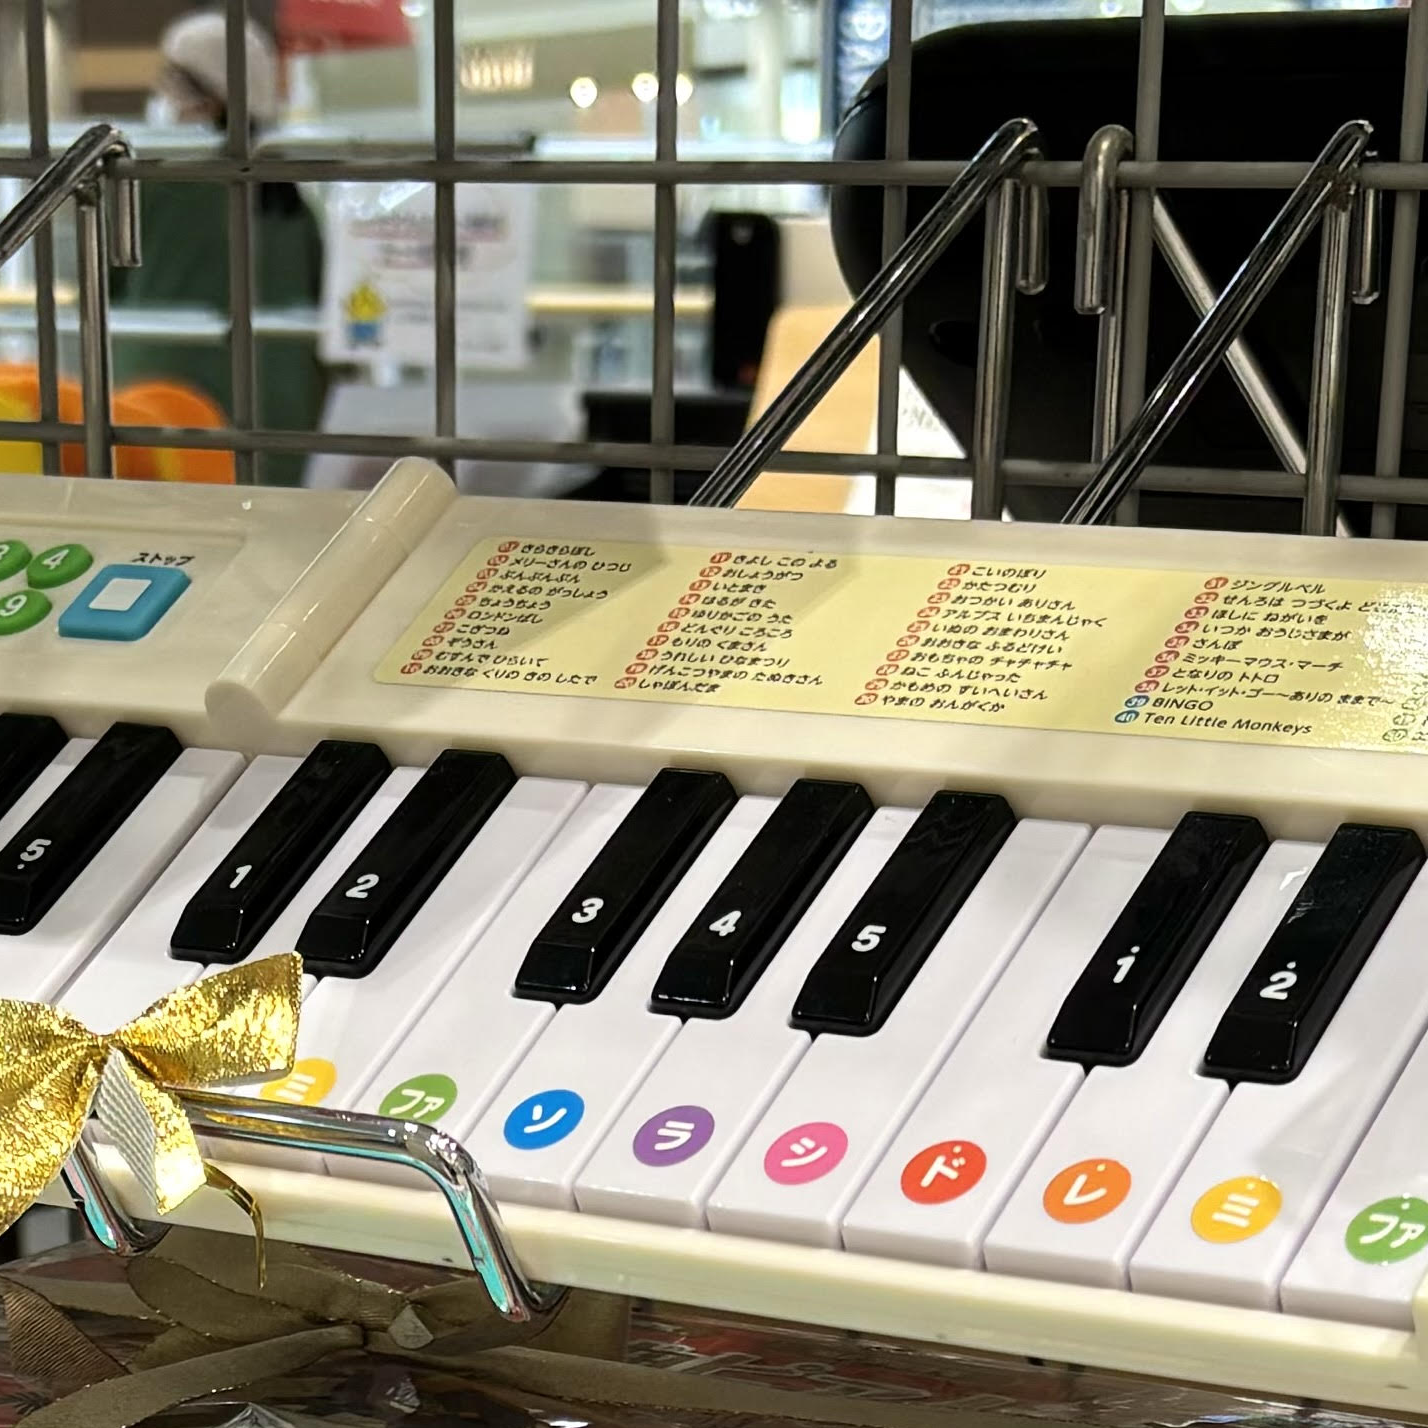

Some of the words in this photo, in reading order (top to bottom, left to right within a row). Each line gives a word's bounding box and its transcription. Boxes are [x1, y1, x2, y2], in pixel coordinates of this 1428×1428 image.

[43, 549, 69, 571] 4
[131, 551, 196, 566] ストップ
[0, 594, 28, 617] 9
[1152, 697, 1213, 711] BINGO
[1232, 718, 1312, 736] Monkeys
[20, 837, 52, 862] 5
[572, 897, 605, 925] 3
[710, 910, 741, 938] 4
[851, 925, 887, 953] 5
